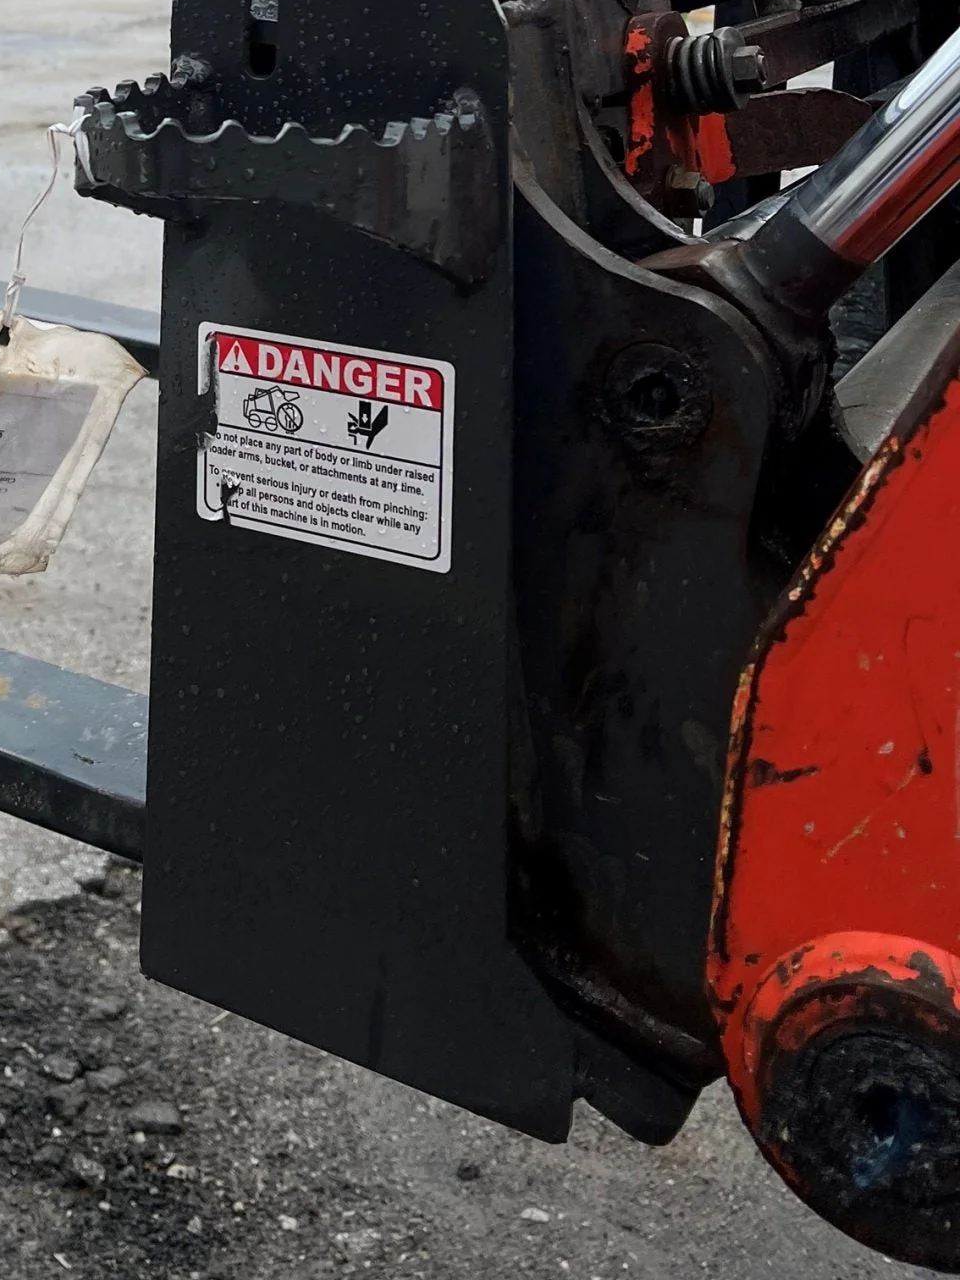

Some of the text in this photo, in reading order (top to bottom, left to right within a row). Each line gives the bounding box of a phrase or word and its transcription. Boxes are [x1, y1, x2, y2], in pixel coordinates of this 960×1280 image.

[258, 343, 432, 407] DANGER
[224, 433, 238, 443] not
[240, 436, 263, 448] place
[266, 441, 281, 453] any
[284, 445, 301, 457] part
[304, 448, 314, 457] of
[316, 449, 337, 465] body
[340, 457, 350, 466] or
[352, 457, 372, 470] limb
[375, 464, 403, 476] under
[405, 469, 434, 482] raised
[238, 450, 263, 464] arms,
[265, 454, 297, 471] bucket,
[300, 463, 309, 472] or
[312, 465, 367, 484] attachments
[370, 477, 379, 486] at
[381, 481, 398, 493] any
[401, 483, 424, 496] time.
[209, 464, 220, 475] To
[256, 476, 289, 490] serious
[291, 482, 317, 497] injury
[319, 489, 329, 498] or
[331, 491, 357, 504] death
[359, 496, 381, 507] from
[383, 502, 428, 521] pinching:
[246, 487, 257, 497] all
[259, 490, 294, 506] persons
[296, 498, 314, 510] and
[315, 503, 349, 518] objects
[351, 510, 375, 523] clear
[376, 516, 401, 529] while
[403, 524, 421, 535] any
[228, 499, 366, 537] art of this machine is in motion.
